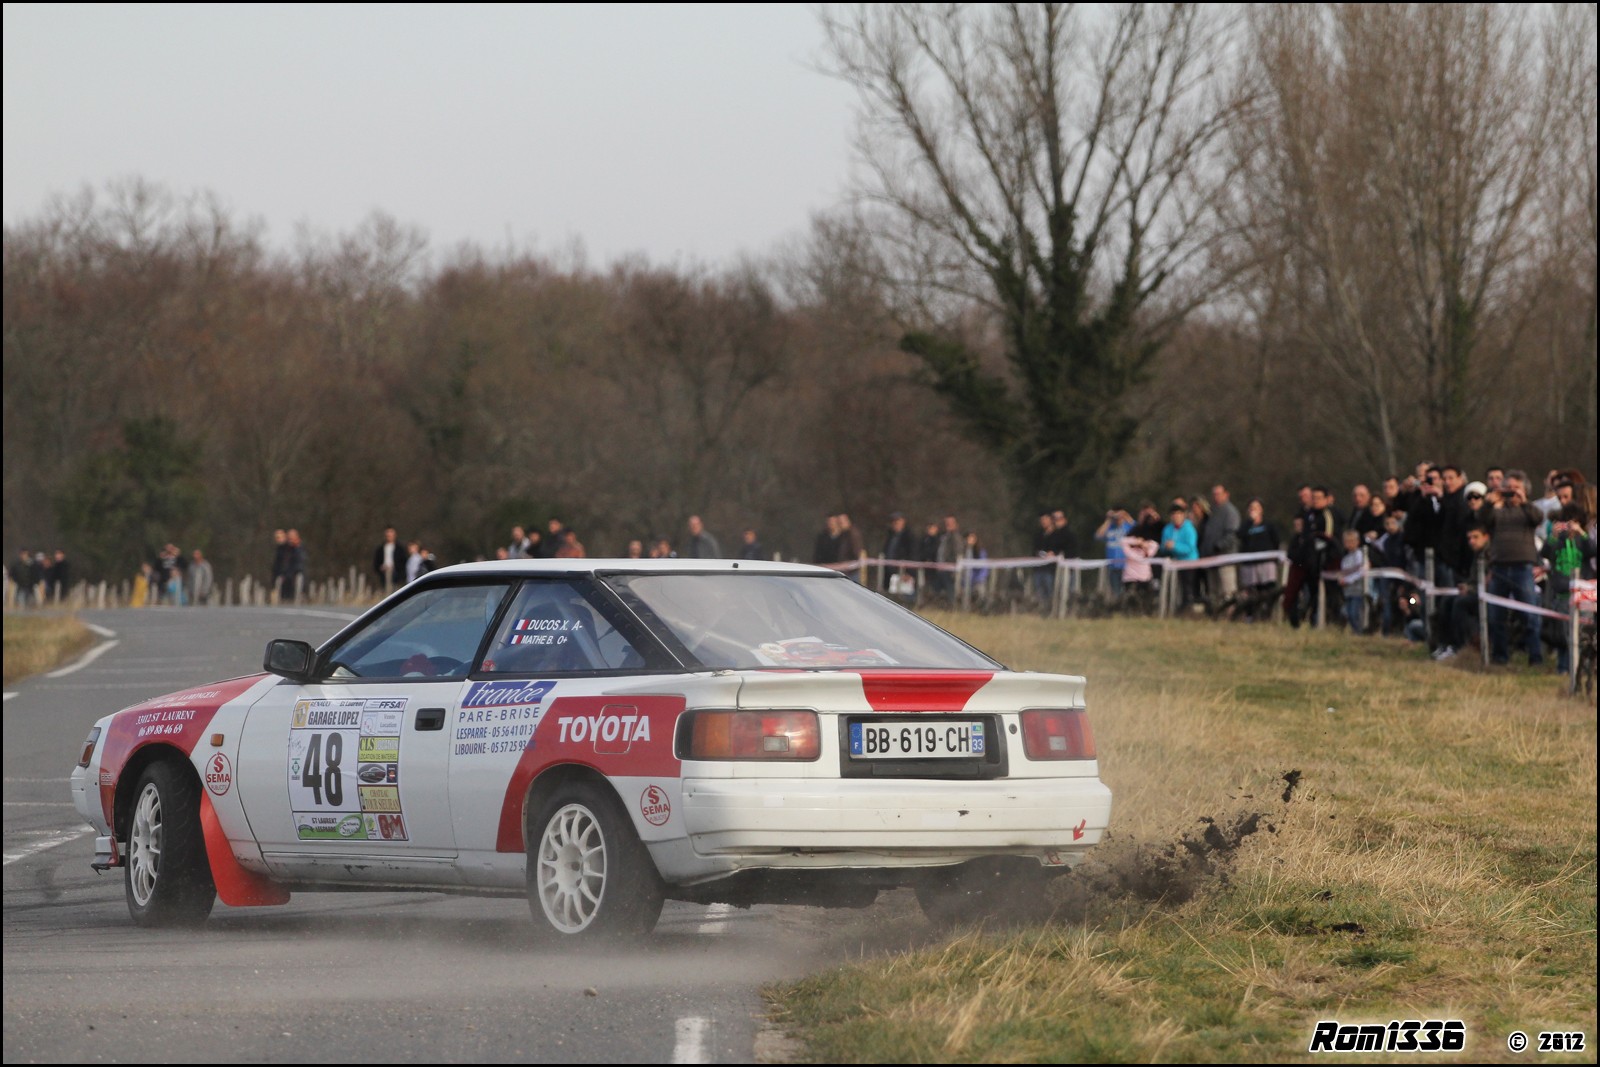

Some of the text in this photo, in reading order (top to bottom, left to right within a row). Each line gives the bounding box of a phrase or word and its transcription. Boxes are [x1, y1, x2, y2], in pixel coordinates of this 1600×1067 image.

[527, 619, 583, 631] DUCOS X. A-
[520, 635, 547, 645] MATHE
[546, 635, 554, 645] B.
[379, 701, 402, 709] FFSA
[161, 710, 196, 721] LAURENT
[308, 711, 359, 726] GARAGE LOPEZ
[459, 707, 540, 723] PARE-BRISE
[138, 724, 183, 737] 06 89 88 46 69
[456, 726, 488, 740] LESPARRE
[492, 726, 500, 738] 05
[501, 725, 510, 737] 56
[510, 725, 519, 736] 41
[519, 724, 528, 735] 01
[558, 715, 651, 743] TOYOTA
[360, 738, 375, 751] CLS
[854, 742, 859, 750] F
[866, 727, 984, 753] BB-619-CH 33
[454, 743, 487, 756] LIBOURNE
[490, 742, 499, 754] 05
[500, 741, 508, 753] 57
[509, 741, 518, 752] 25
[303, 732, 343, 807] 48
[207, 773, 231, 783] SEMA
[643, 803, 670, 816] SEMA
